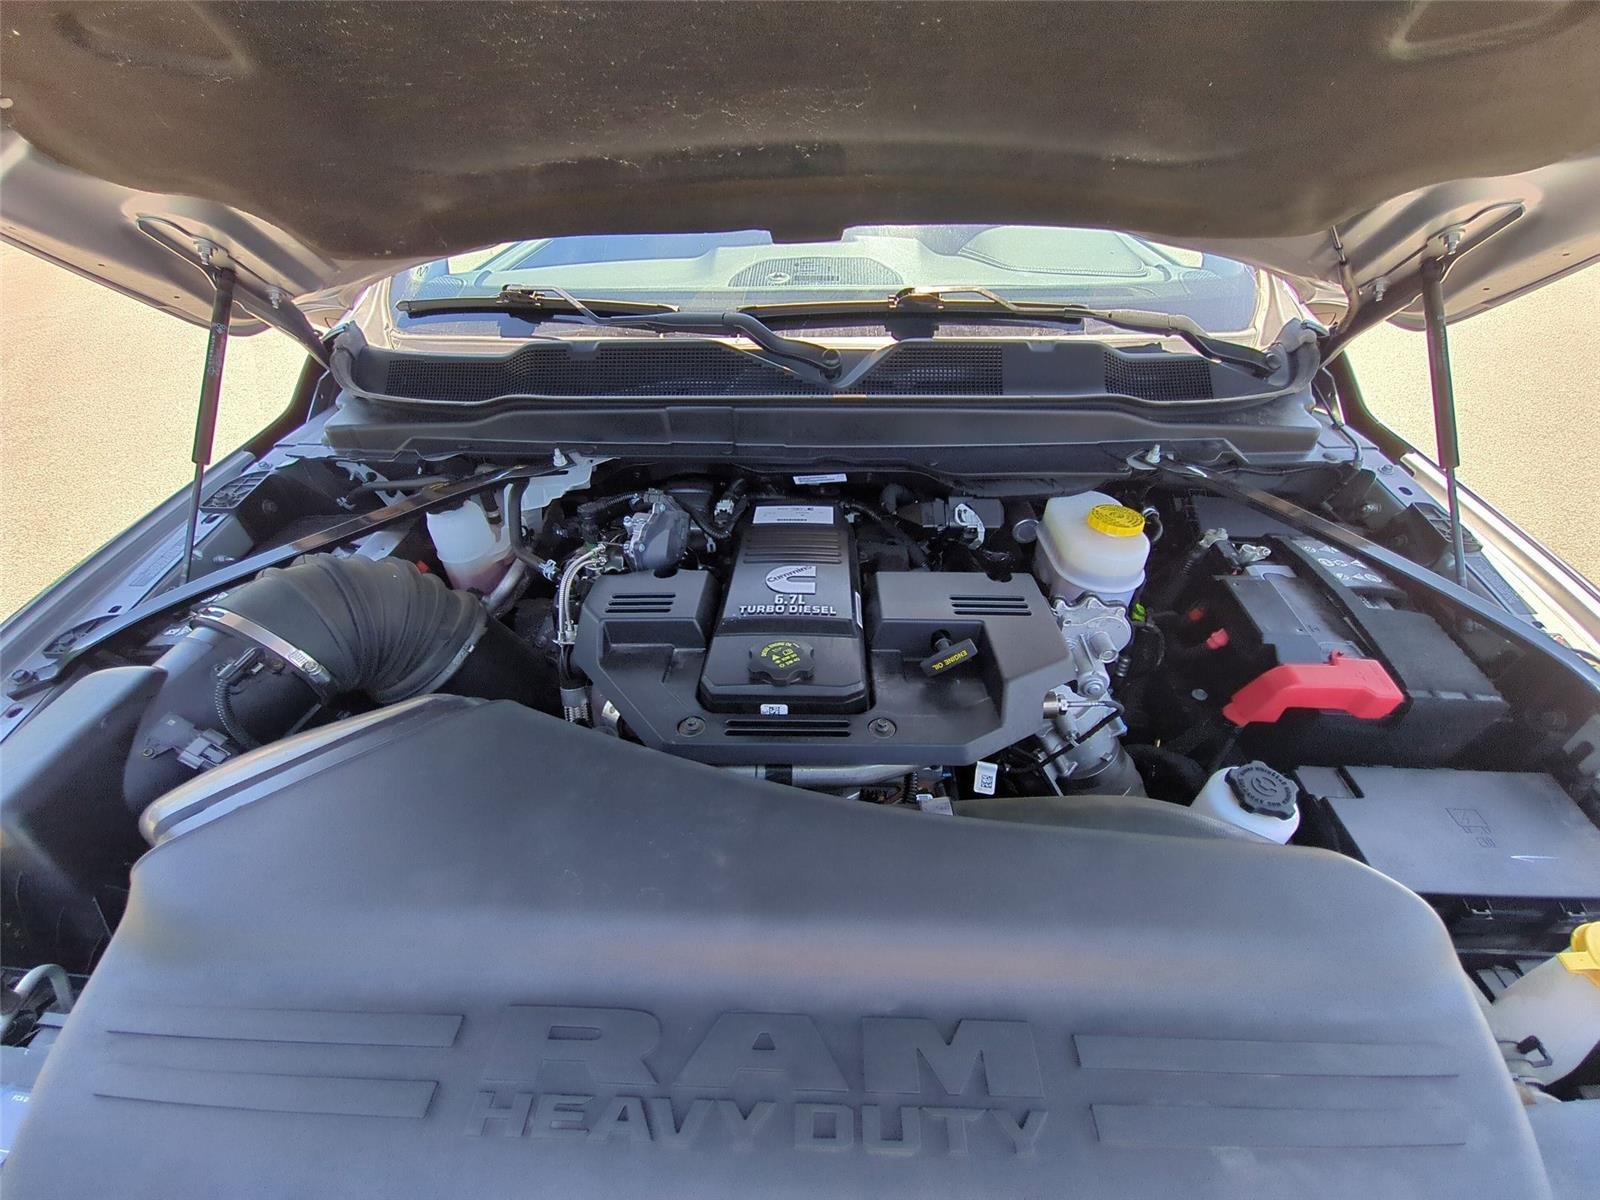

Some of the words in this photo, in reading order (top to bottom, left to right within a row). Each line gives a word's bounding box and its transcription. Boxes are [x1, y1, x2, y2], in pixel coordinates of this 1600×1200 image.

[774, 594, 806, 605] 6.7L
[740, 605, 785, 615] TURBO
[788, 605, 837, 616] DIESEL
[943, 649, 968, 666] ENGINE
[931, 661, 944, 670] OIL
[481, 1003, 1046, 1098] RAM
[464, 1091, 779, 1150] HEAVY
[794, 1101, 1049, 1158] DUTY
